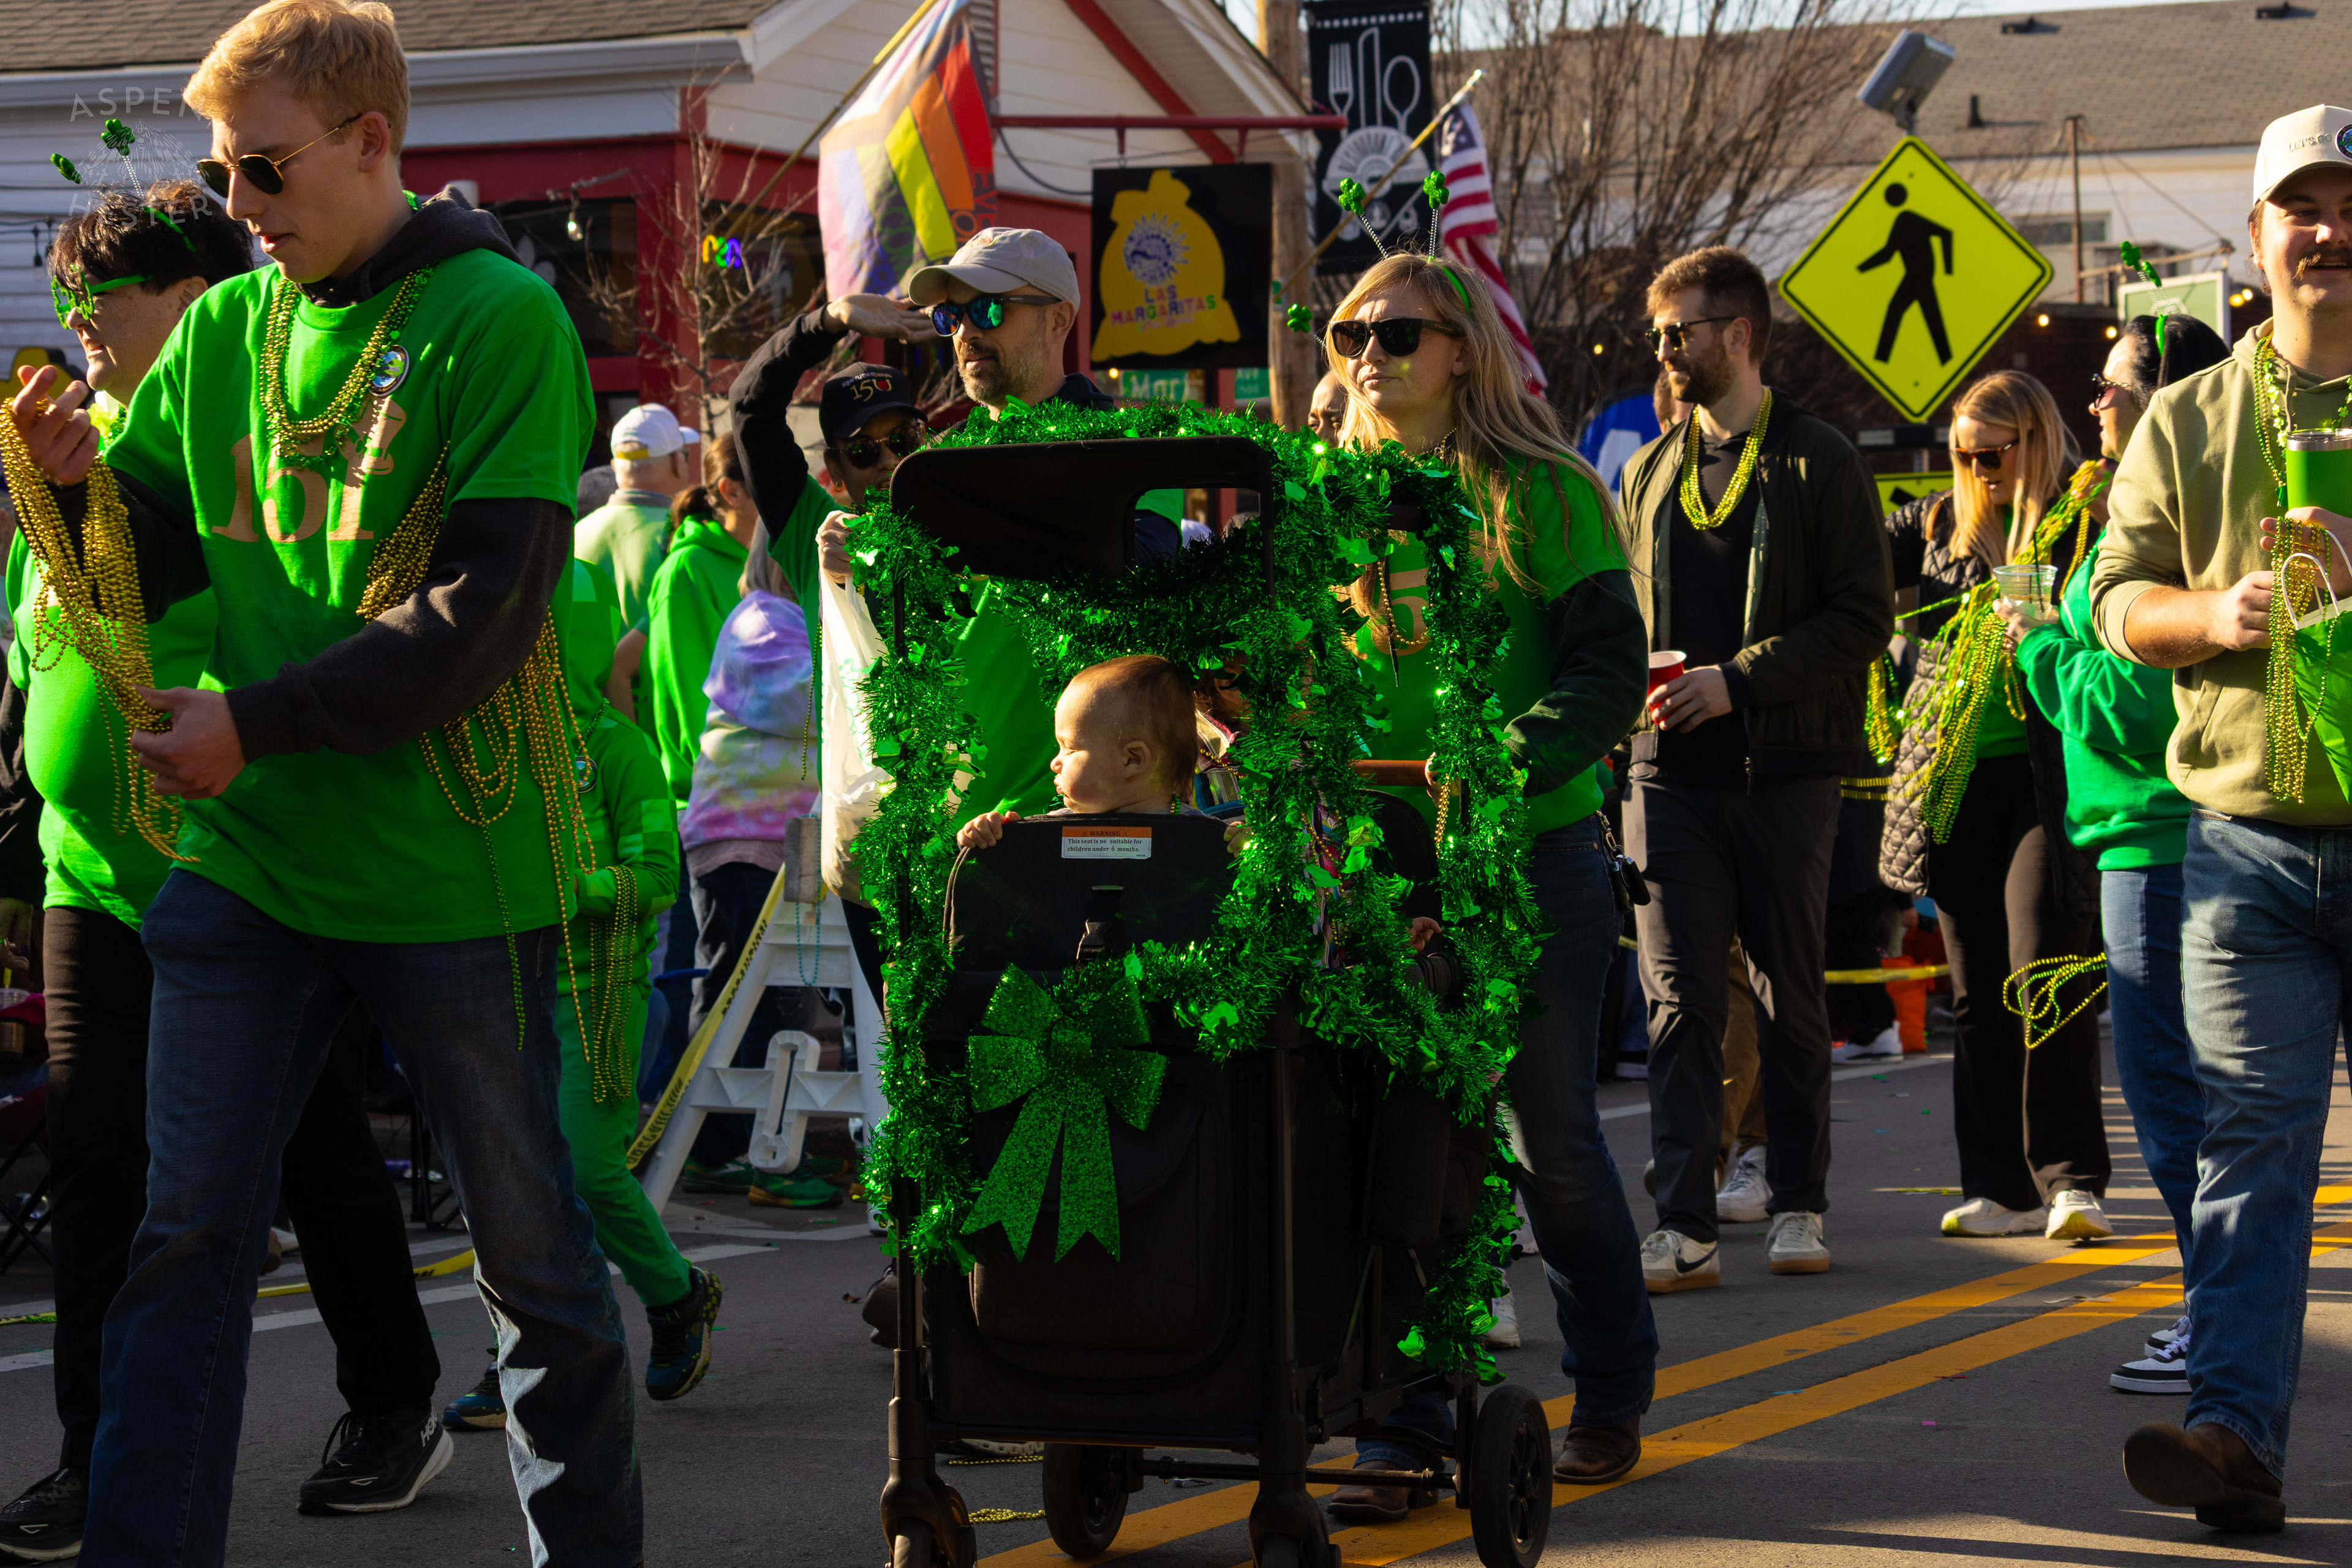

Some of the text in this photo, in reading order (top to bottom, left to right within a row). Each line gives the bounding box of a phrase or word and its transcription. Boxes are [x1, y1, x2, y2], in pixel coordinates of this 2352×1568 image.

[2317, 134, 2332, 144] GO
[1144, 284, 1178, 304] LAS
[1110, 294, 1216, 326] MARGARITAS
